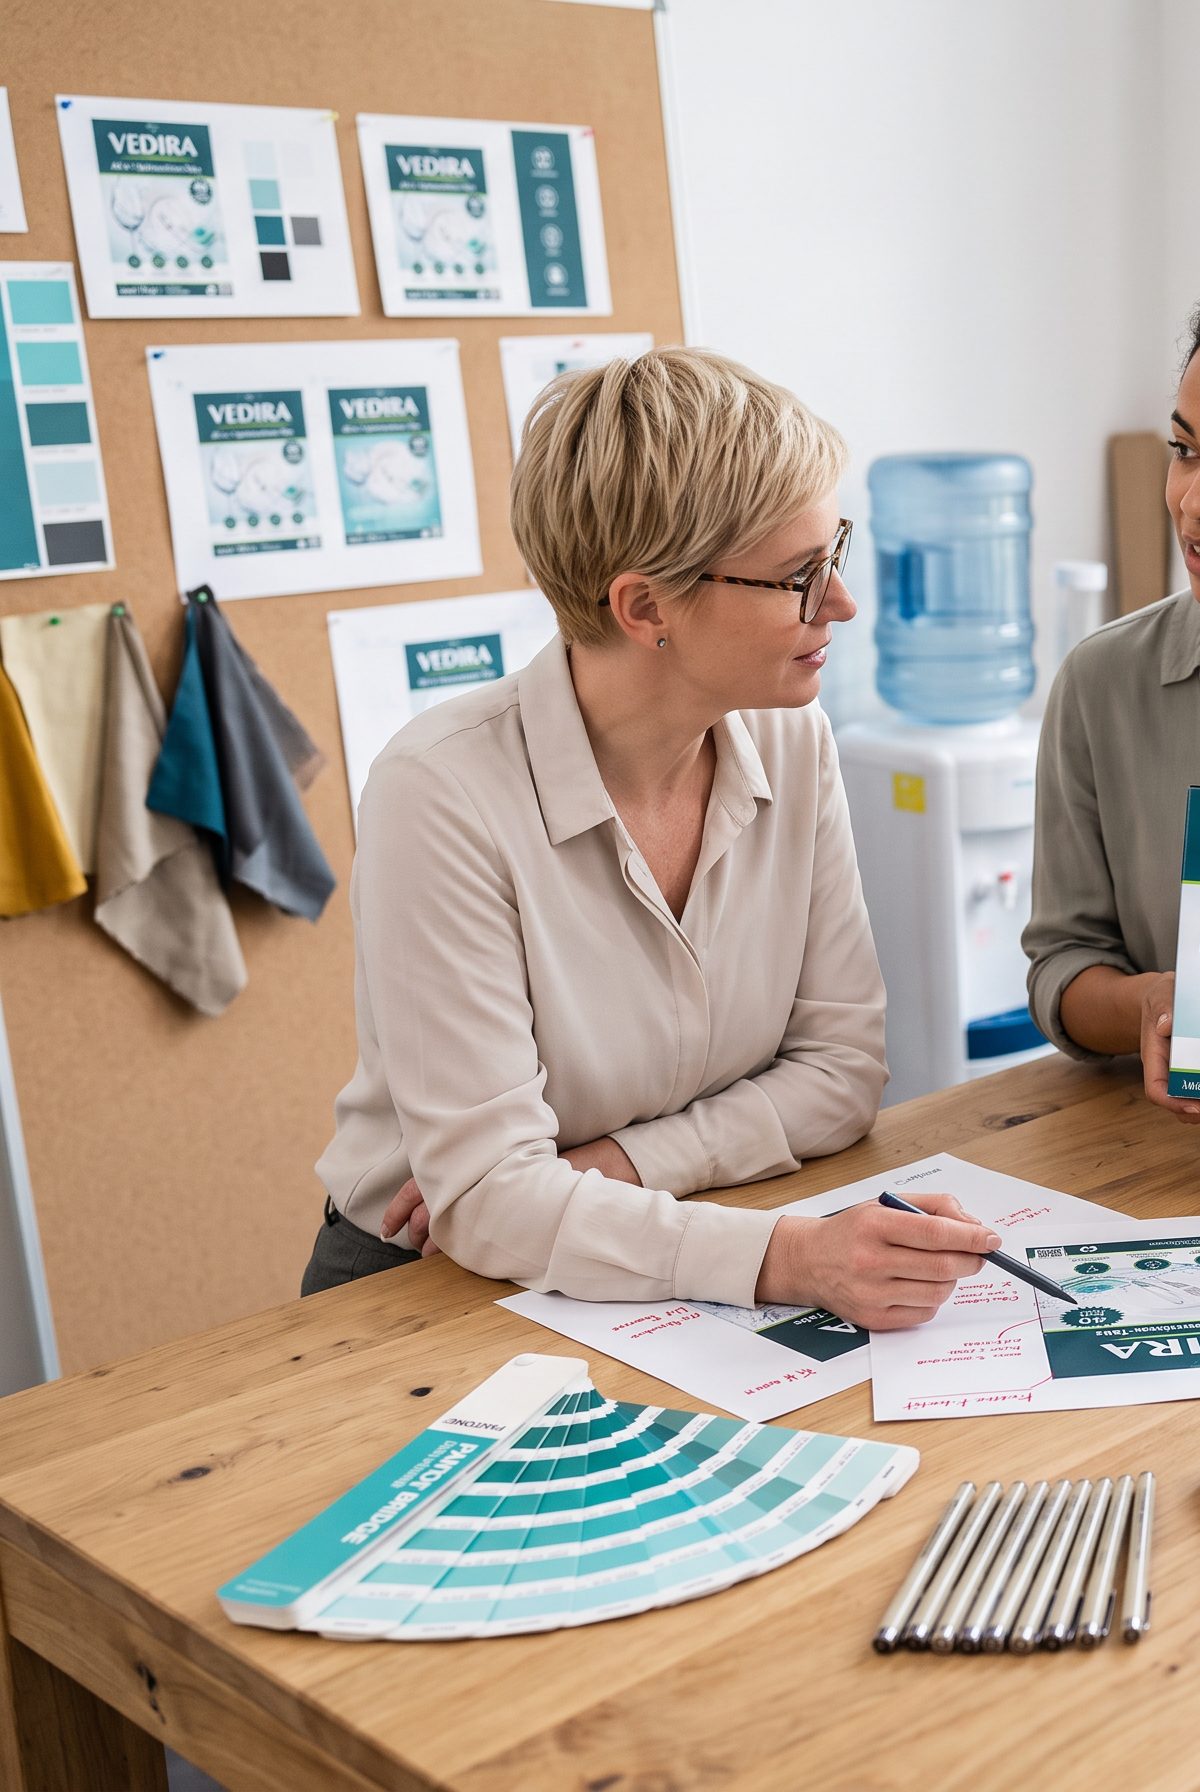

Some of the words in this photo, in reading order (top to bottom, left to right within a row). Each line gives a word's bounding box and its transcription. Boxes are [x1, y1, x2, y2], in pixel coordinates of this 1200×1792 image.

[107, 131, 199, 158] VEDIRA
[395, 153, 476, 179] VEDIRA
[207, 400, 293, 426] VEDIRA
[339, 395, 420, 420] VEDIRA
[415, 643, 494, 673] VEDIRA
[340, 1490, 419, 1546] BRIDGE
